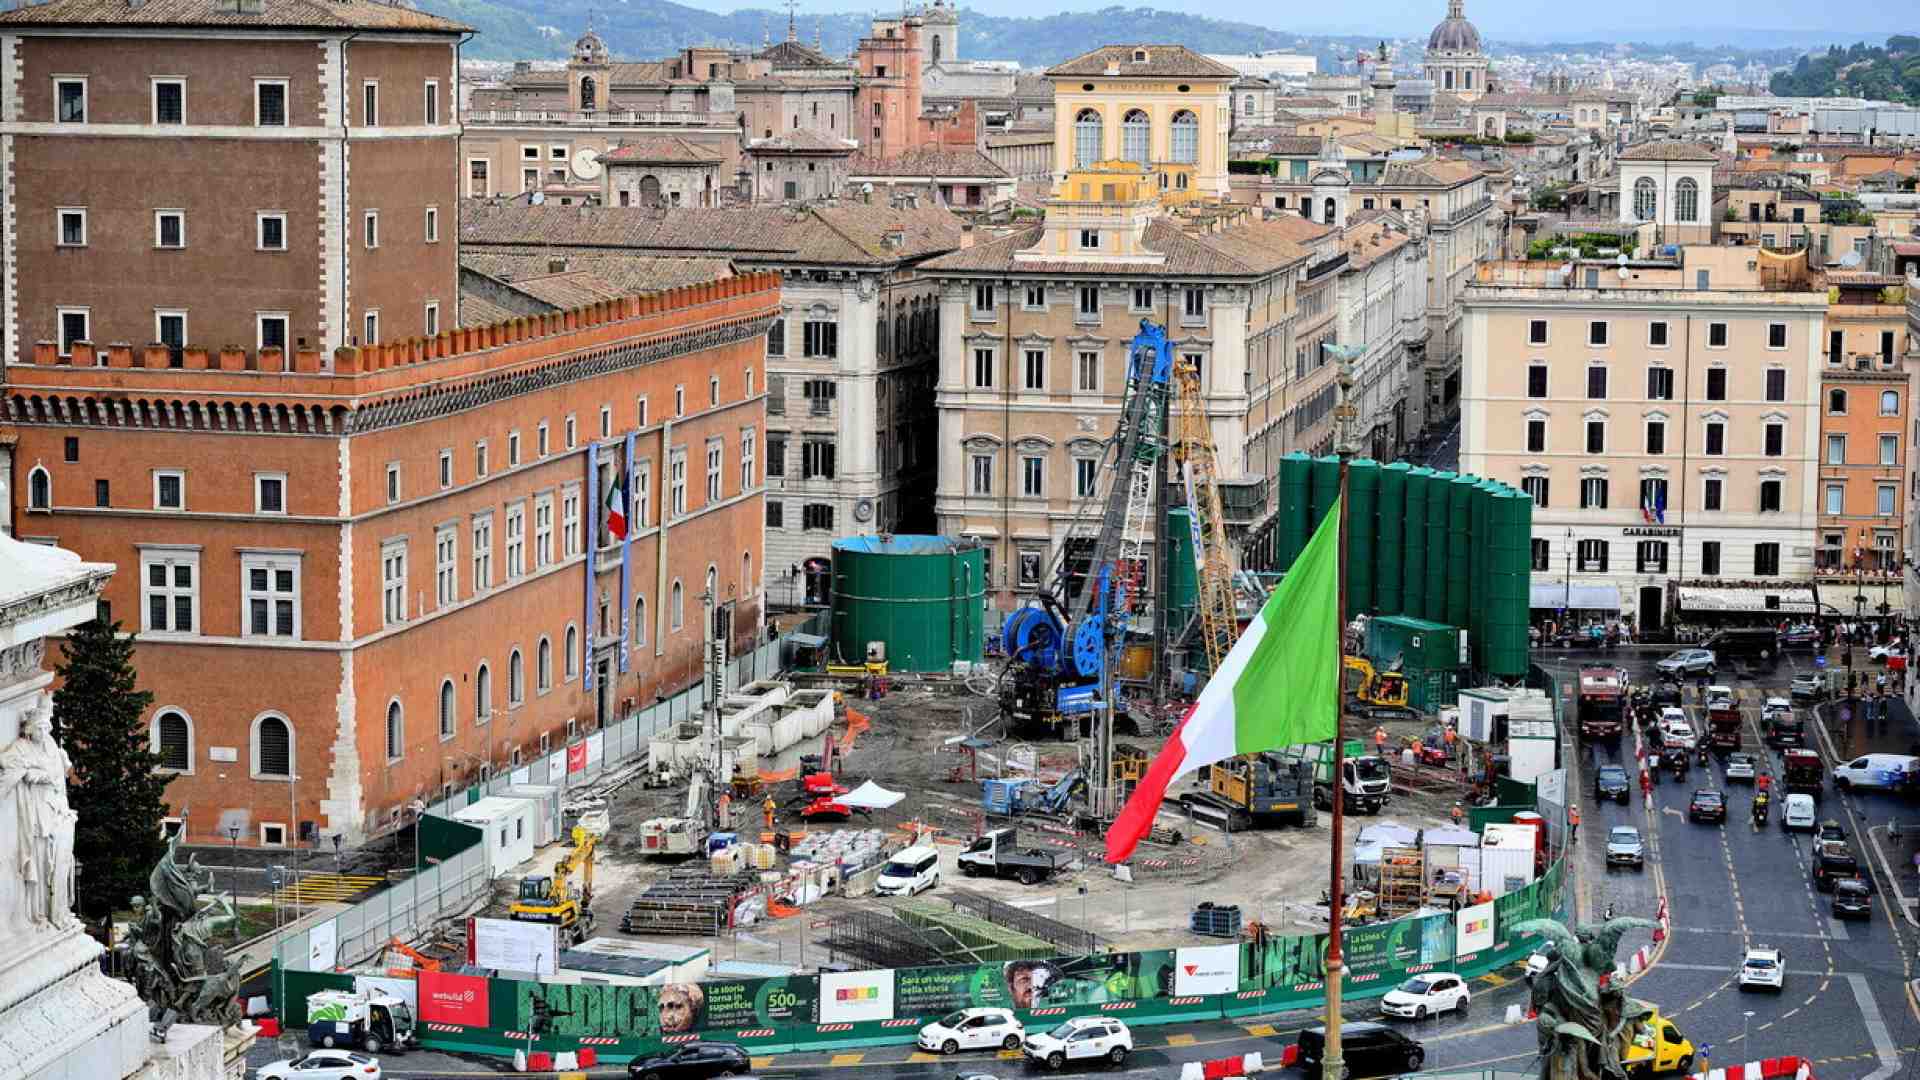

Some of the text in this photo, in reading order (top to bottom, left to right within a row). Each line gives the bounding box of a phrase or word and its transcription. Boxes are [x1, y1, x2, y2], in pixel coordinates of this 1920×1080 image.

[1623, 528, 1682, 536] CARABINIERI
[709, 984, 745, 994] La storia
[709, 993, 743, 1002] torna in
[768, 994, 796, 1007] 500
[709, 1001, 752, 1011] superficie
